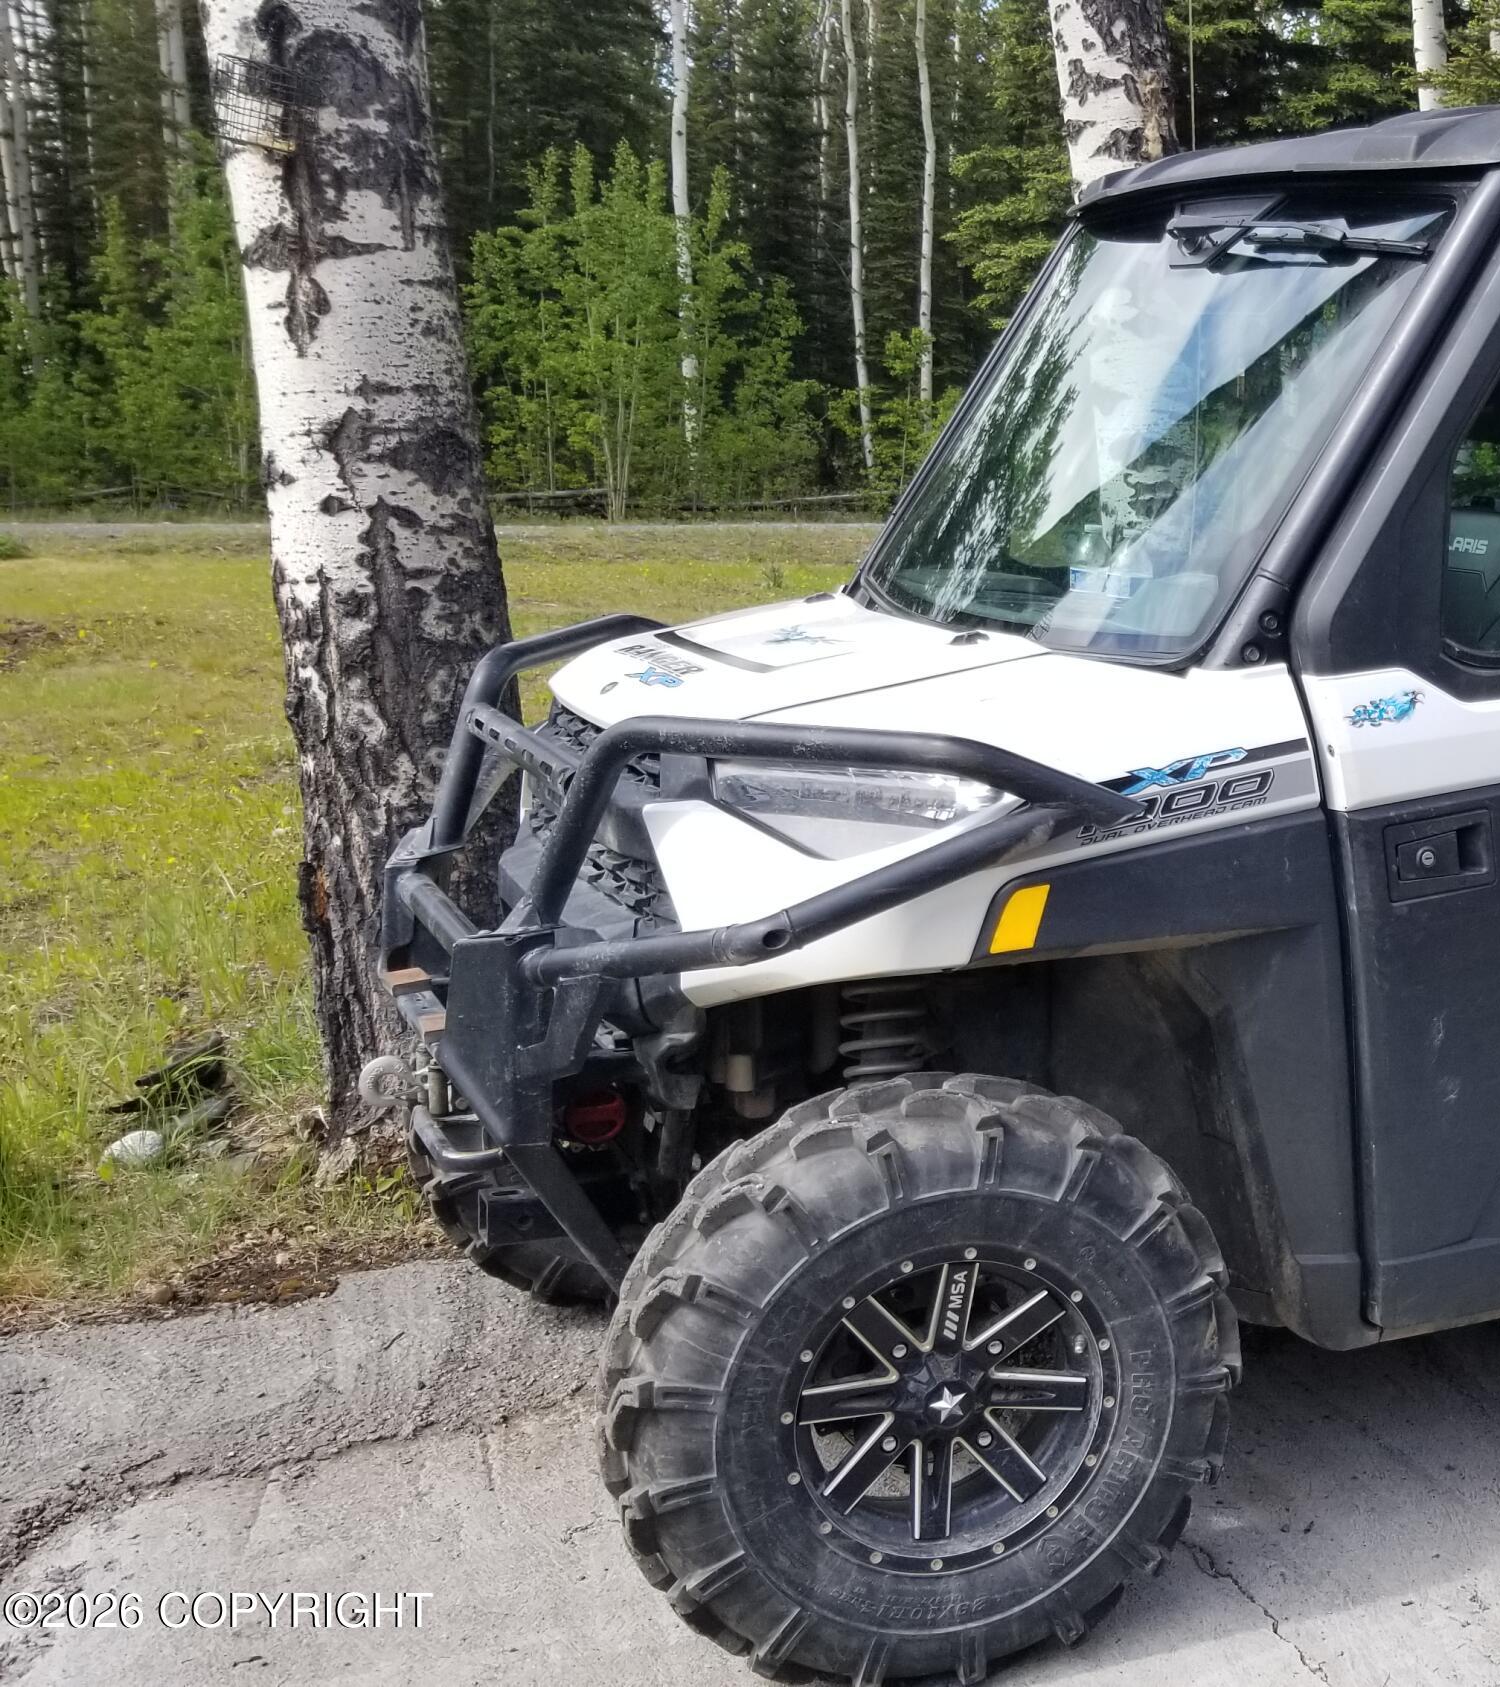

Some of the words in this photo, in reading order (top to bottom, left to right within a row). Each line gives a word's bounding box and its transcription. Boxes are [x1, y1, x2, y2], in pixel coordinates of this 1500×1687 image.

[1448, 536, 1488, 554] ARIS
[613, 645, 704, 676] RANGER
[624, 666, 684, 688] XP
[1118, 747, 1249, 796] XP
[1080, 830, 1128, 846] DUAL
[1134, 806, 1227, 833] OVERHEAD
[1230, 797, 1268, 810] CAM
[948, 1270, 969, 1309] MSA
